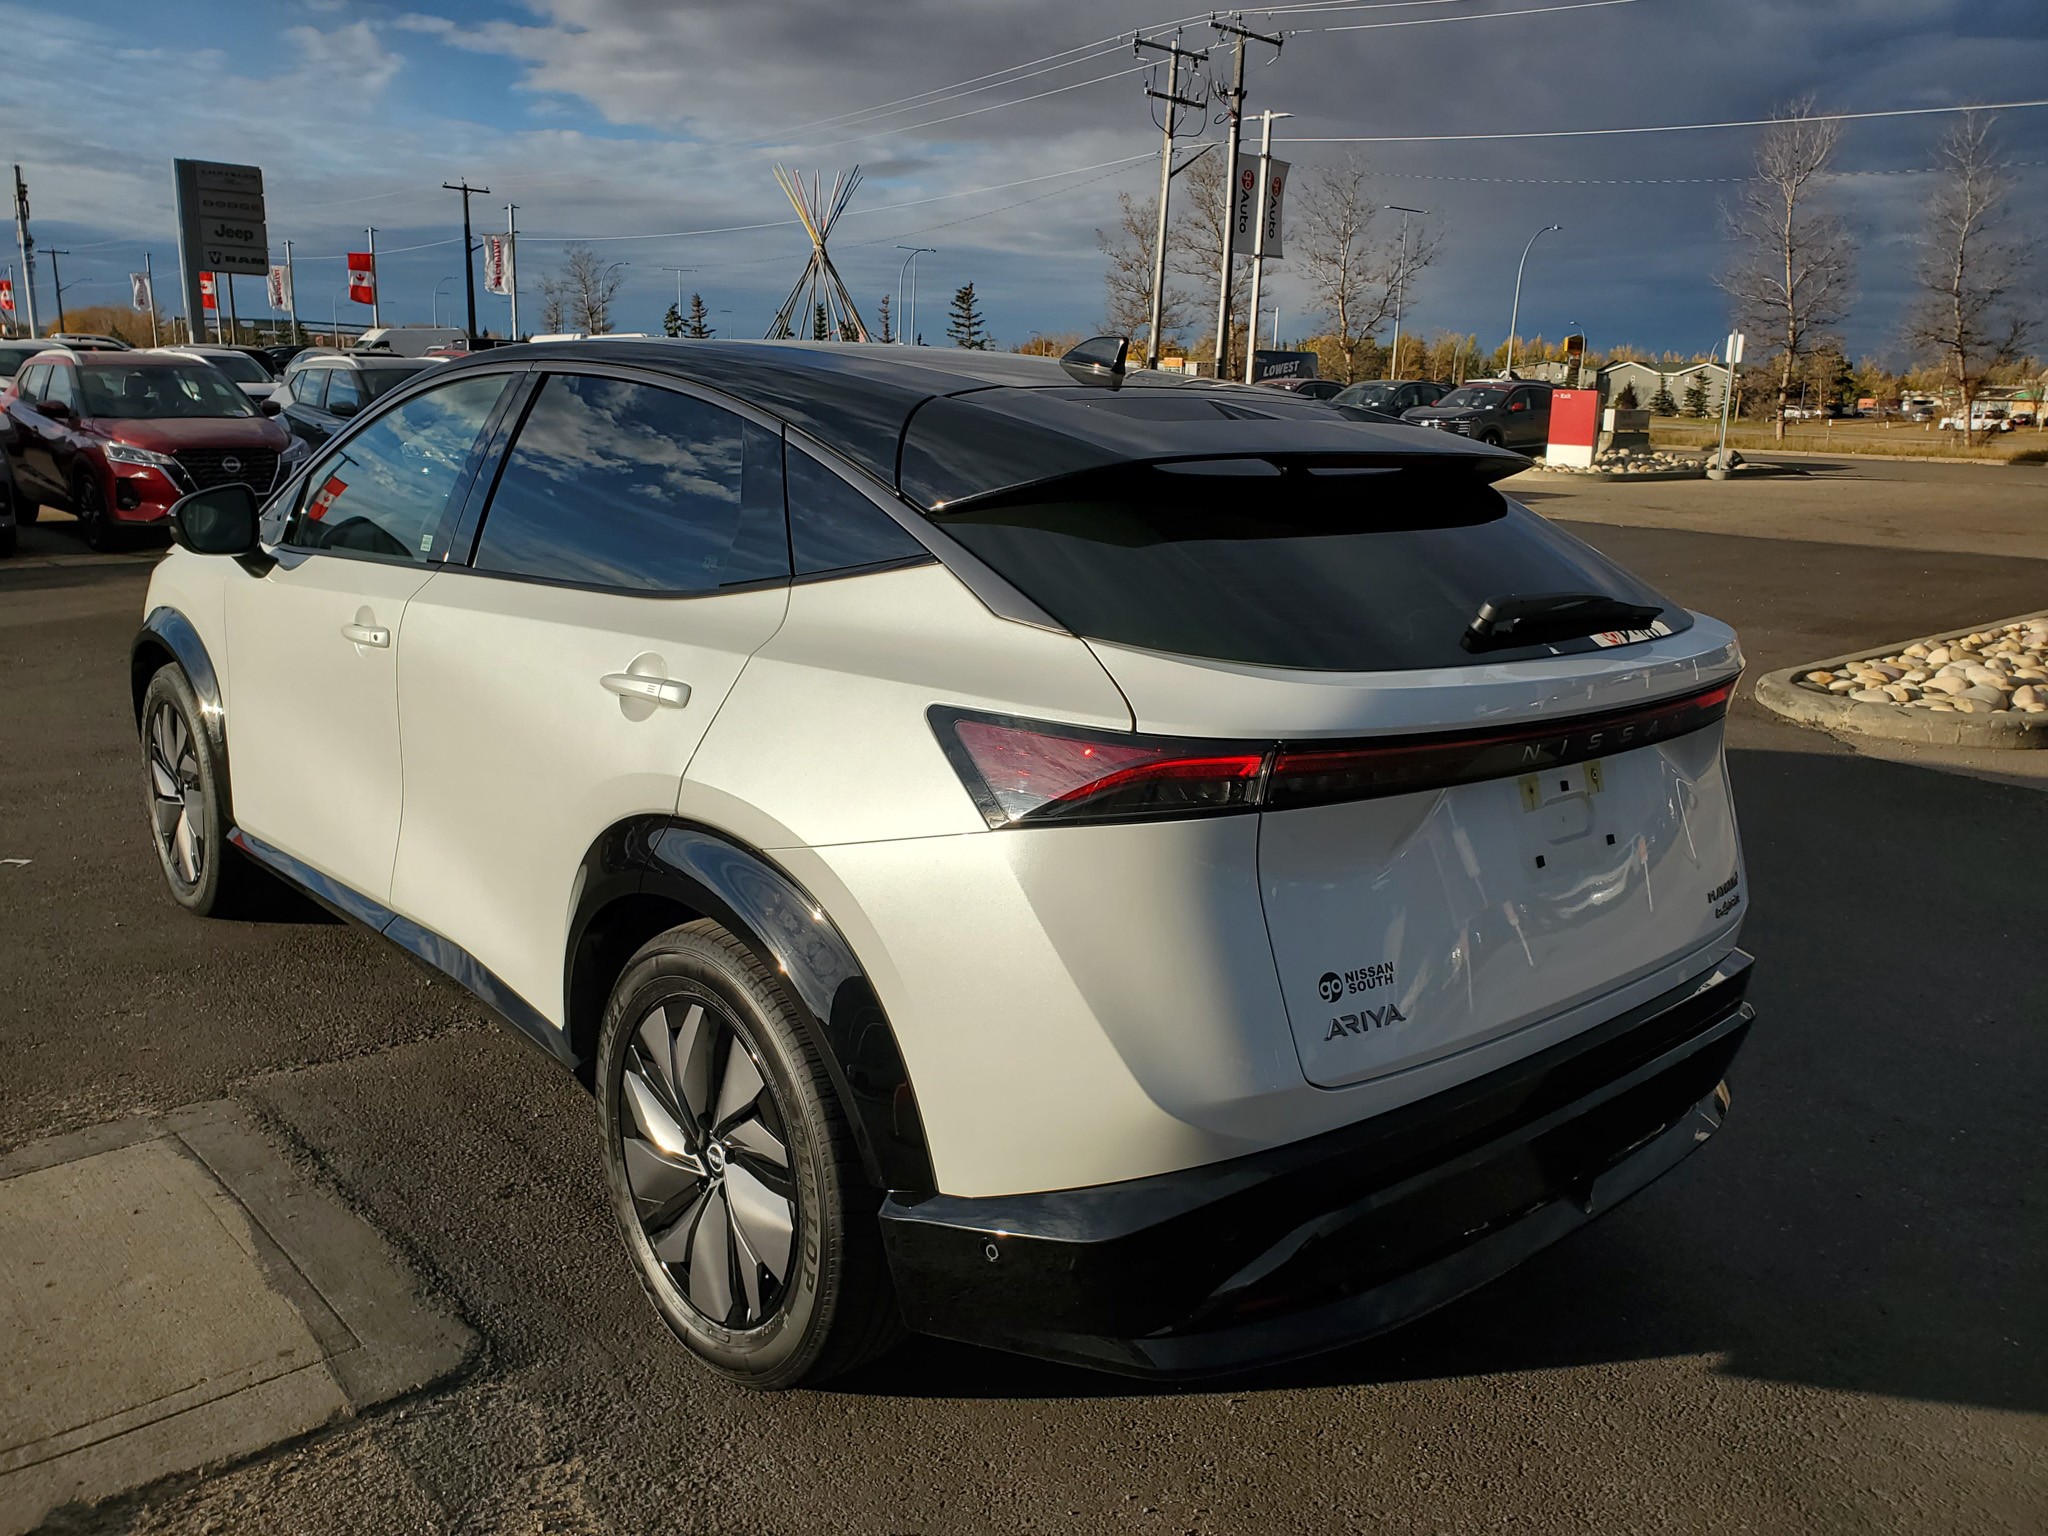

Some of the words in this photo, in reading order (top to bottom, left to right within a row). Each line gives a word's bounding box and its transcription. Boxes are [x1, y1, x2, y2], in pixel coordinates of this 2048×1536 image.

[202, 199, 261, 211] DODGE
[1239, 189, 1250, 233] Auto
[1269, 196, 1278, 239] Auto
[214, 224, 254, 241] Jeep
[225, 255, 266, 265] RAM
[1263, 360, 1300, 377] LOWEST
[1521, 713, 1685, 763] NISSAN
[1344, 961, 1395, 984] NISSAN
[1348, 973, 1394, 995] SOUTH
[1319, 975, 1343, 1003] go
[1323, 1003, 1407, 1041] ARIYA
[793, 1123, 819, 1295] DUNLOP
